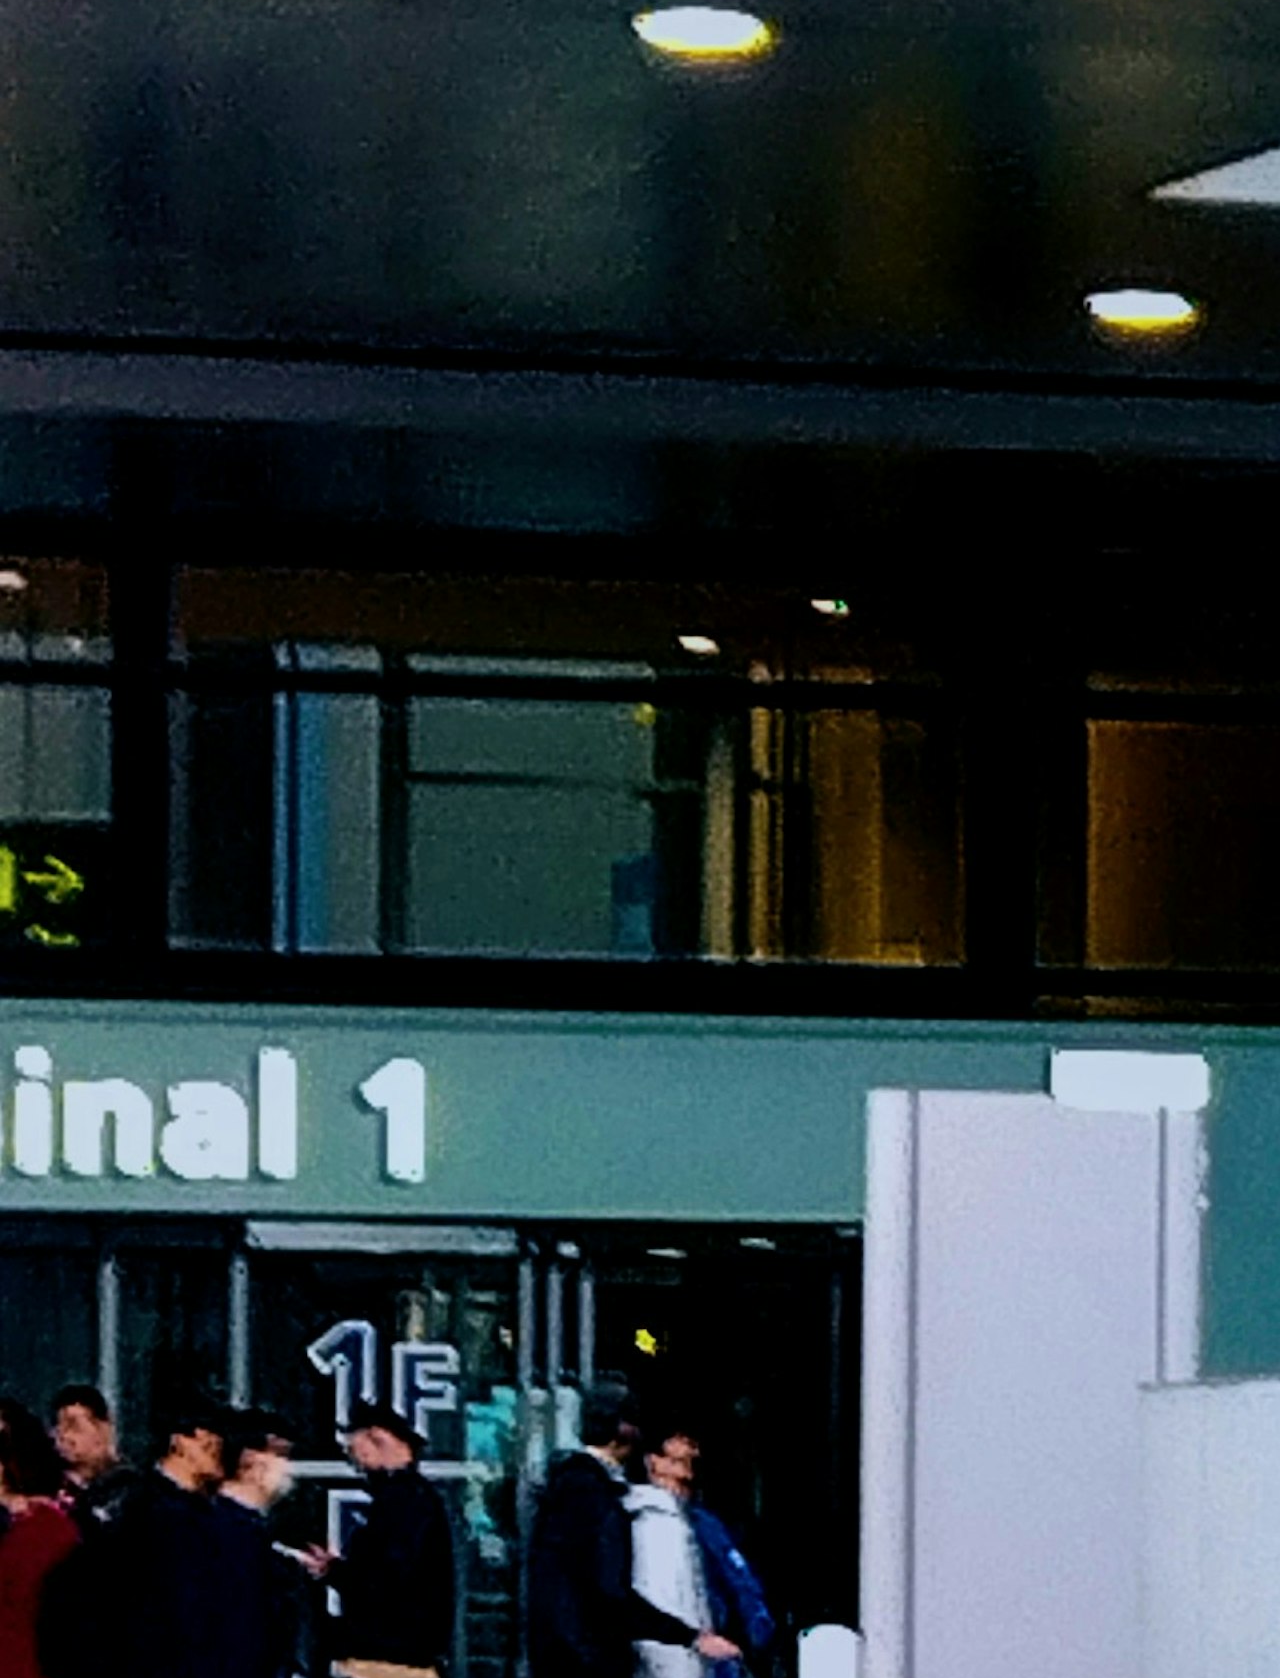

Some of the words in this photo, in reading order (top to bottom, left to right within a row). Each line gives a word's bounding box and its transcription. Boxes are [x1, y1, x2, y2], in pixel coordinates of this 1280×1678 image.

[0, 1045, 297, 1180] inal
[358, 1057, 426, 1183] 1
[306, 1320, 460, 1448] 1F
